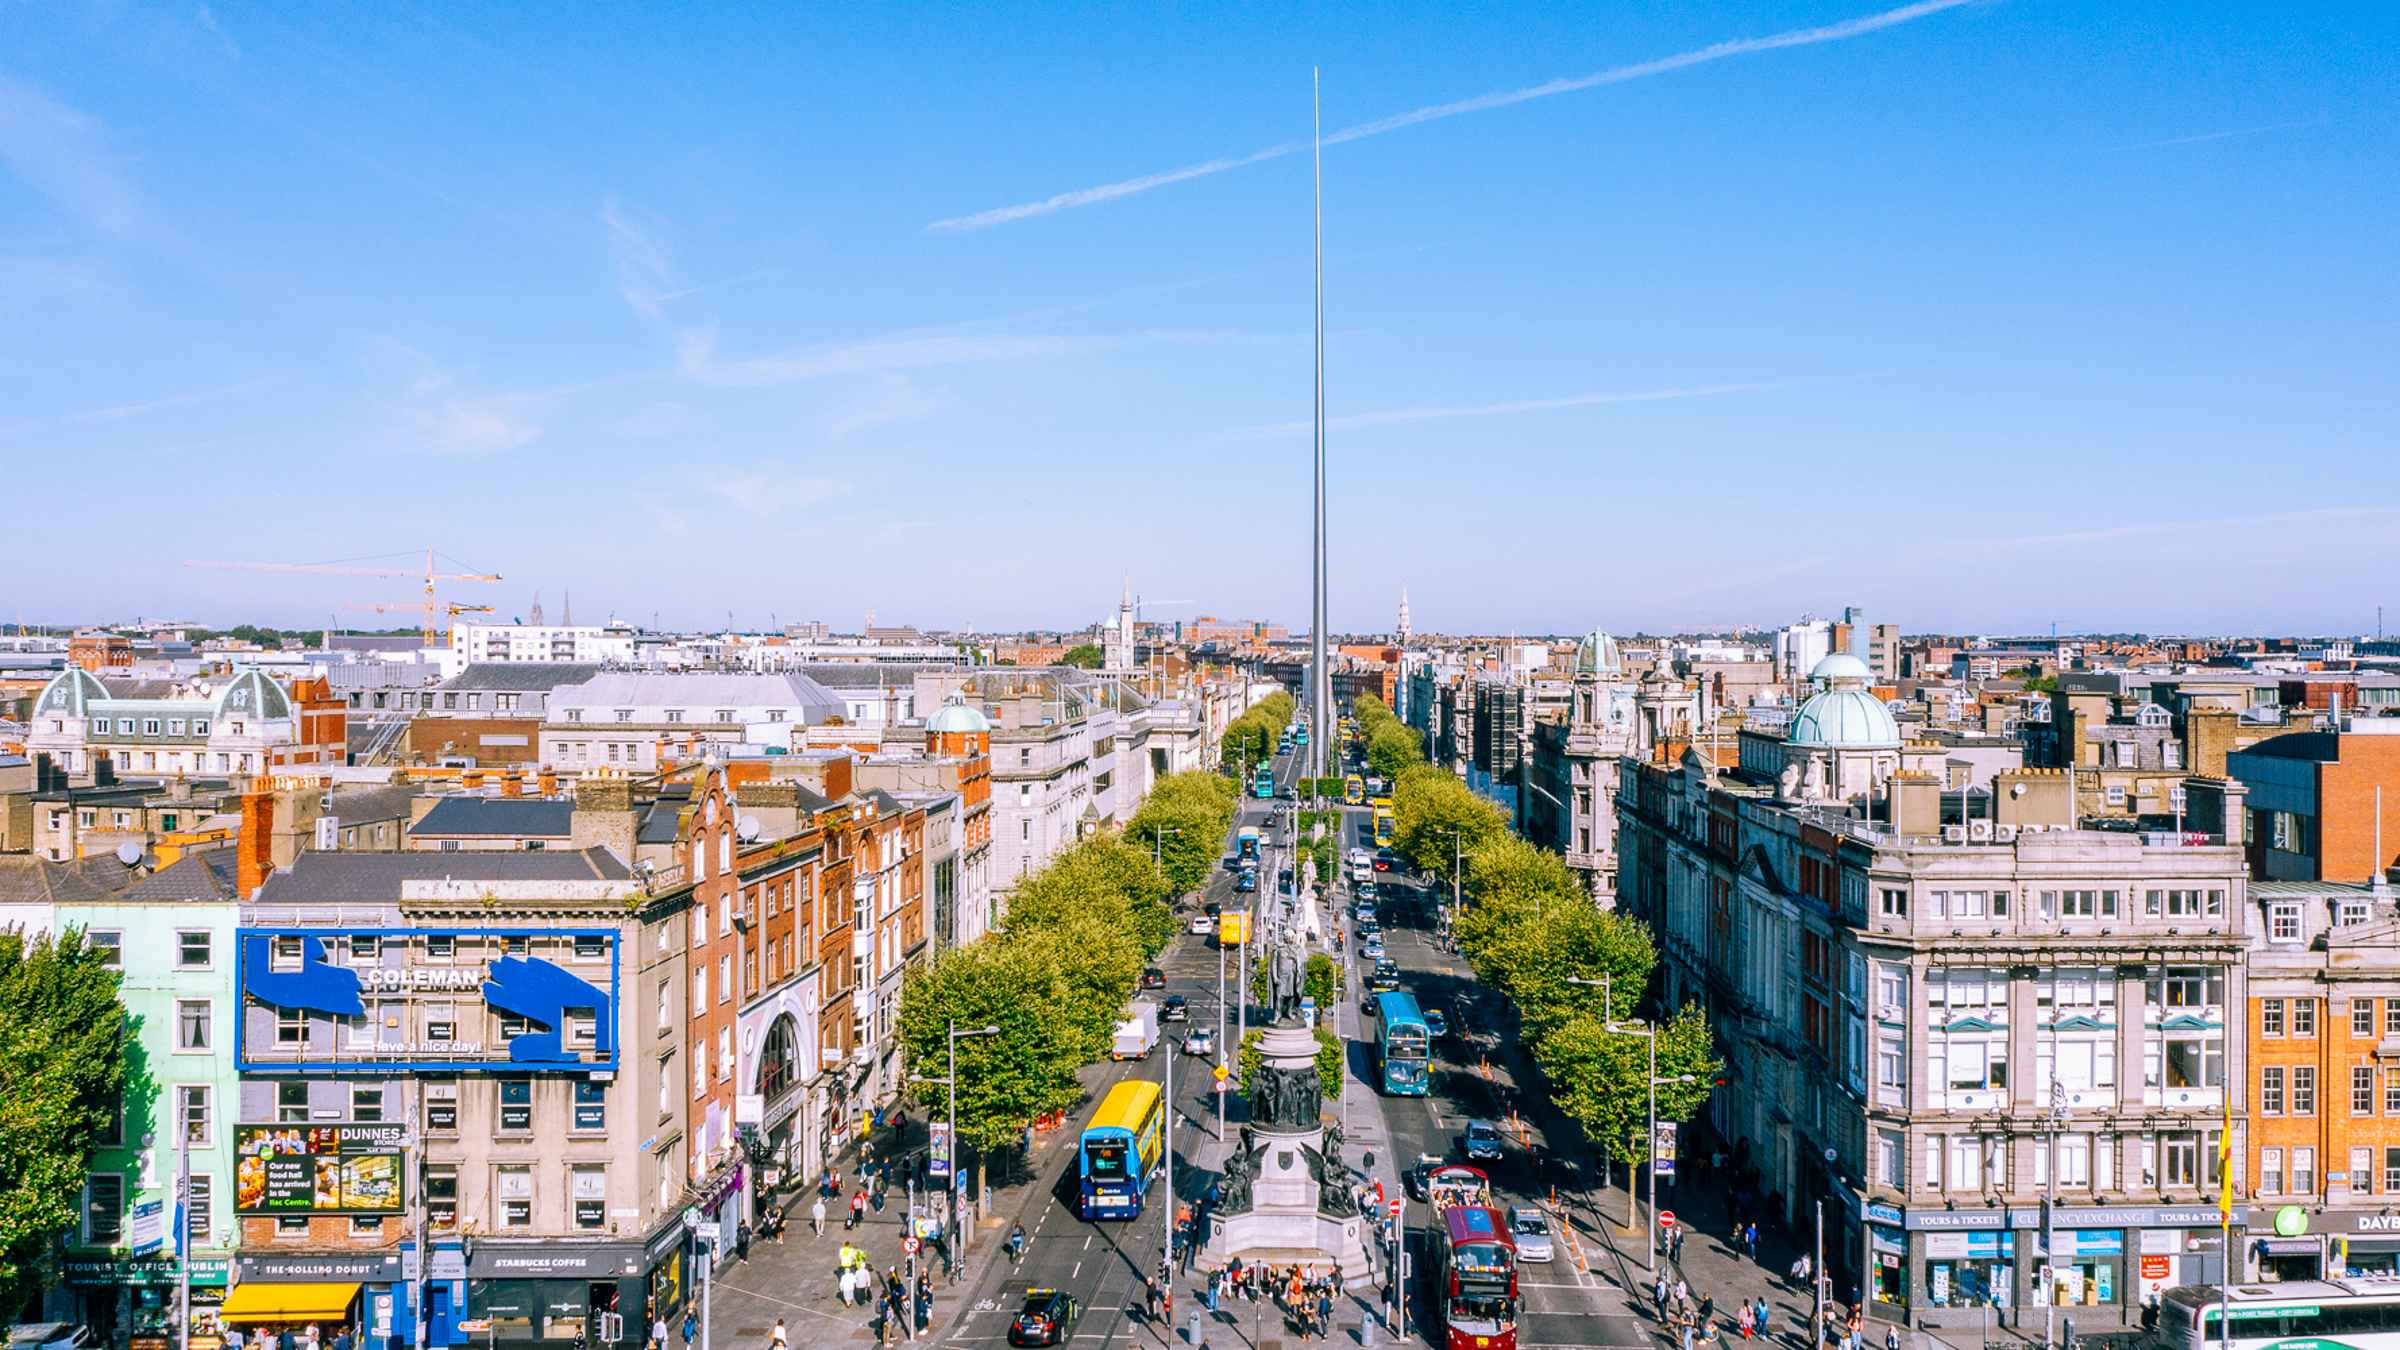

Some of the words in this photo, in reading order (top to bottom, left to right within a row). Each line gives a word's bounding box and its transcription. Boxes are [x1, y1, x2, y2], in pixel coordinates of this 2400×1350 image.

[368, 969, 480, 985] COLEMAN
[420, 1041, 448, 1052] nice
[452, 1041, 482, 1055] day!
[341, 1128, 400, 1140] DUNNES
[269, 1162, 284, 1170] Our
[1919, 1215, 1951, 1226] TOURS
[1952, 1216, 1960, 1225] &
[1961, 1214, 2000, 1225] TICKETS
[2018, 1213, 2082, 1225] CUENCY
[2160, 1213, 2191, 1223] TOURS
[2192, 1213, 2200, 1222] &
[2200, 1212, 2240, 1222] TICKTS
[2358, 1216, 2400, 1230] DAYB
[67, 1262, 120, 1272] TOURIST
[184, 1262, 228, 1271] UBLIN
[494, 1258, 551, 1268] STARBUCKS
[552, 1258, 587, 1267] COFFEE
[336, 1265, 370, 1274] DONUT
